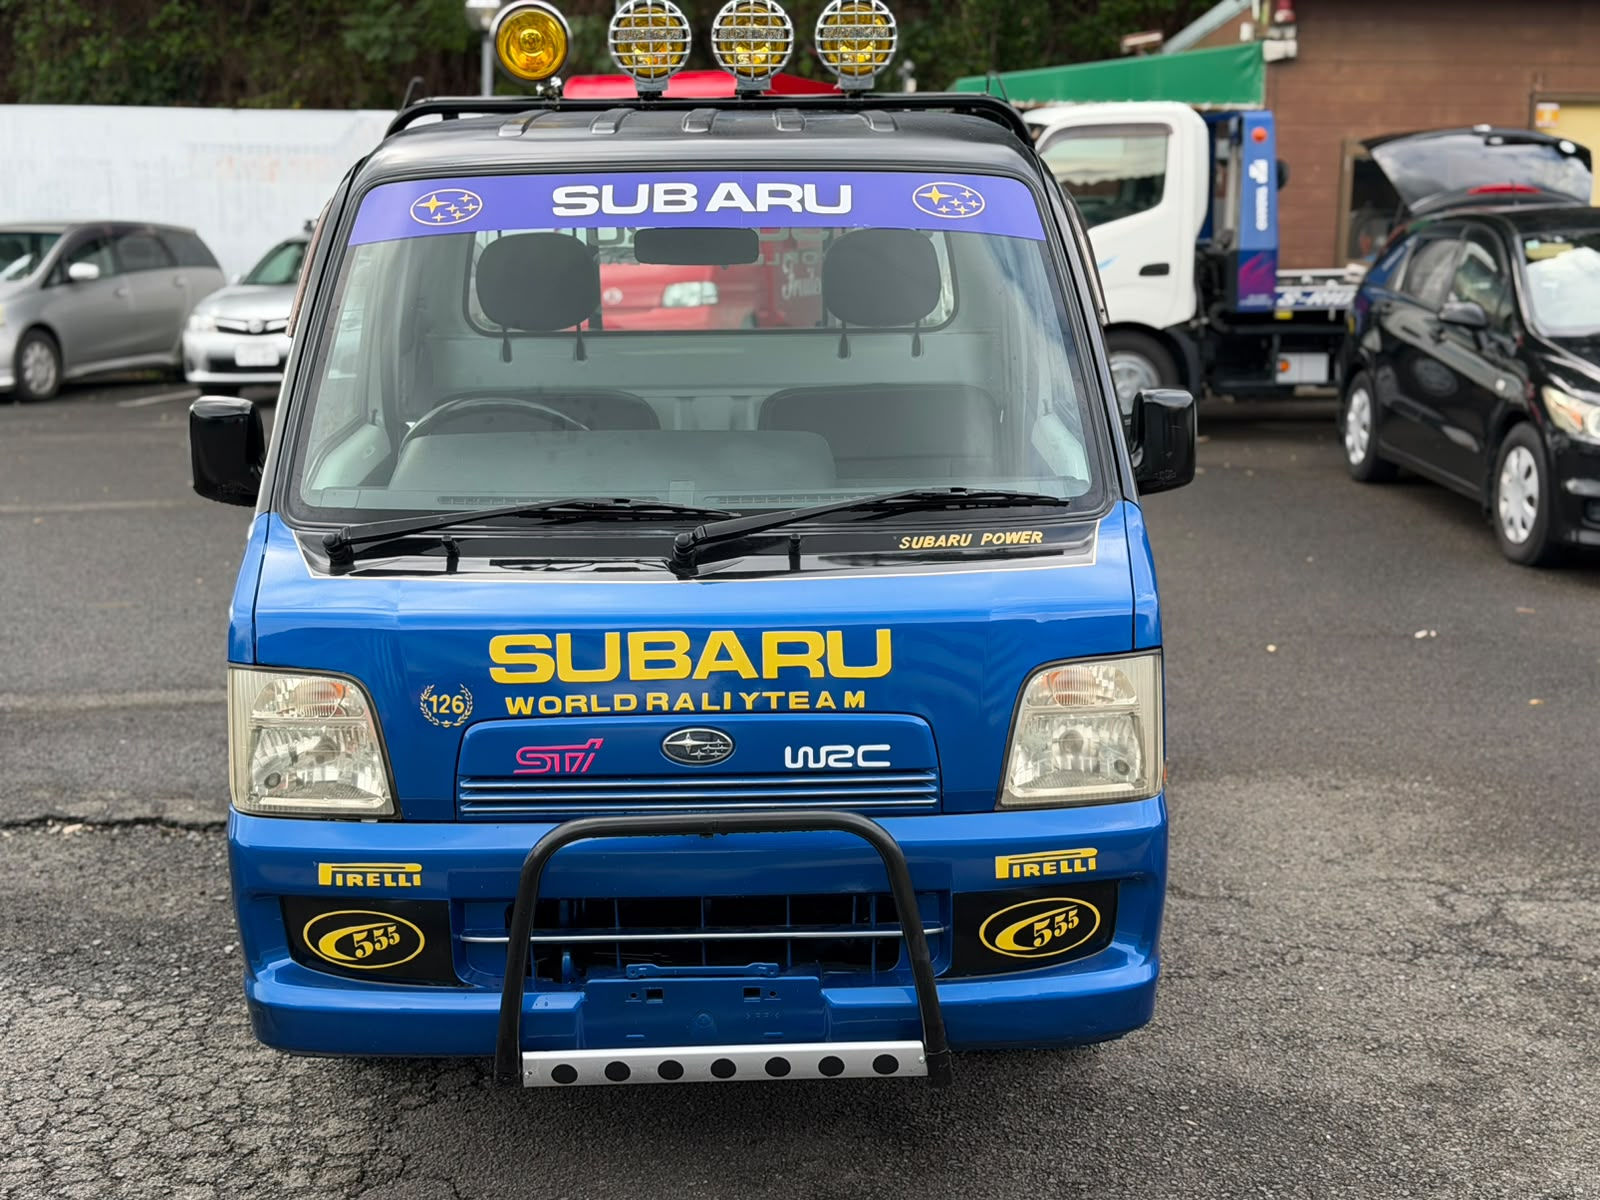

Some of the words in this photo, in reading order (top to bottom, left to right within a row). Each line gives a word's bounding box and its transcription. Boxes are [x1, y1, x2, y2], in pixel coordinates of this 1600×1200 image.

[552, 182, 852, 217] SUBARU
[899, 533, 972, 549] SUBARU
[980, 531, 1043, 545] POWER
[489, 629, 892, 683] SUBARU
[429, 694, 465, 714] 126
[505, 694, 638, 715] WORLD
[785, 744, 891, 768] WRC
[318, 863, 422, 887] PIRELLI
[995, 847, 1098, 879] PIRELLI
[352, 925, 400, 958] 555
[1033, 909, 1080, 948] 555
